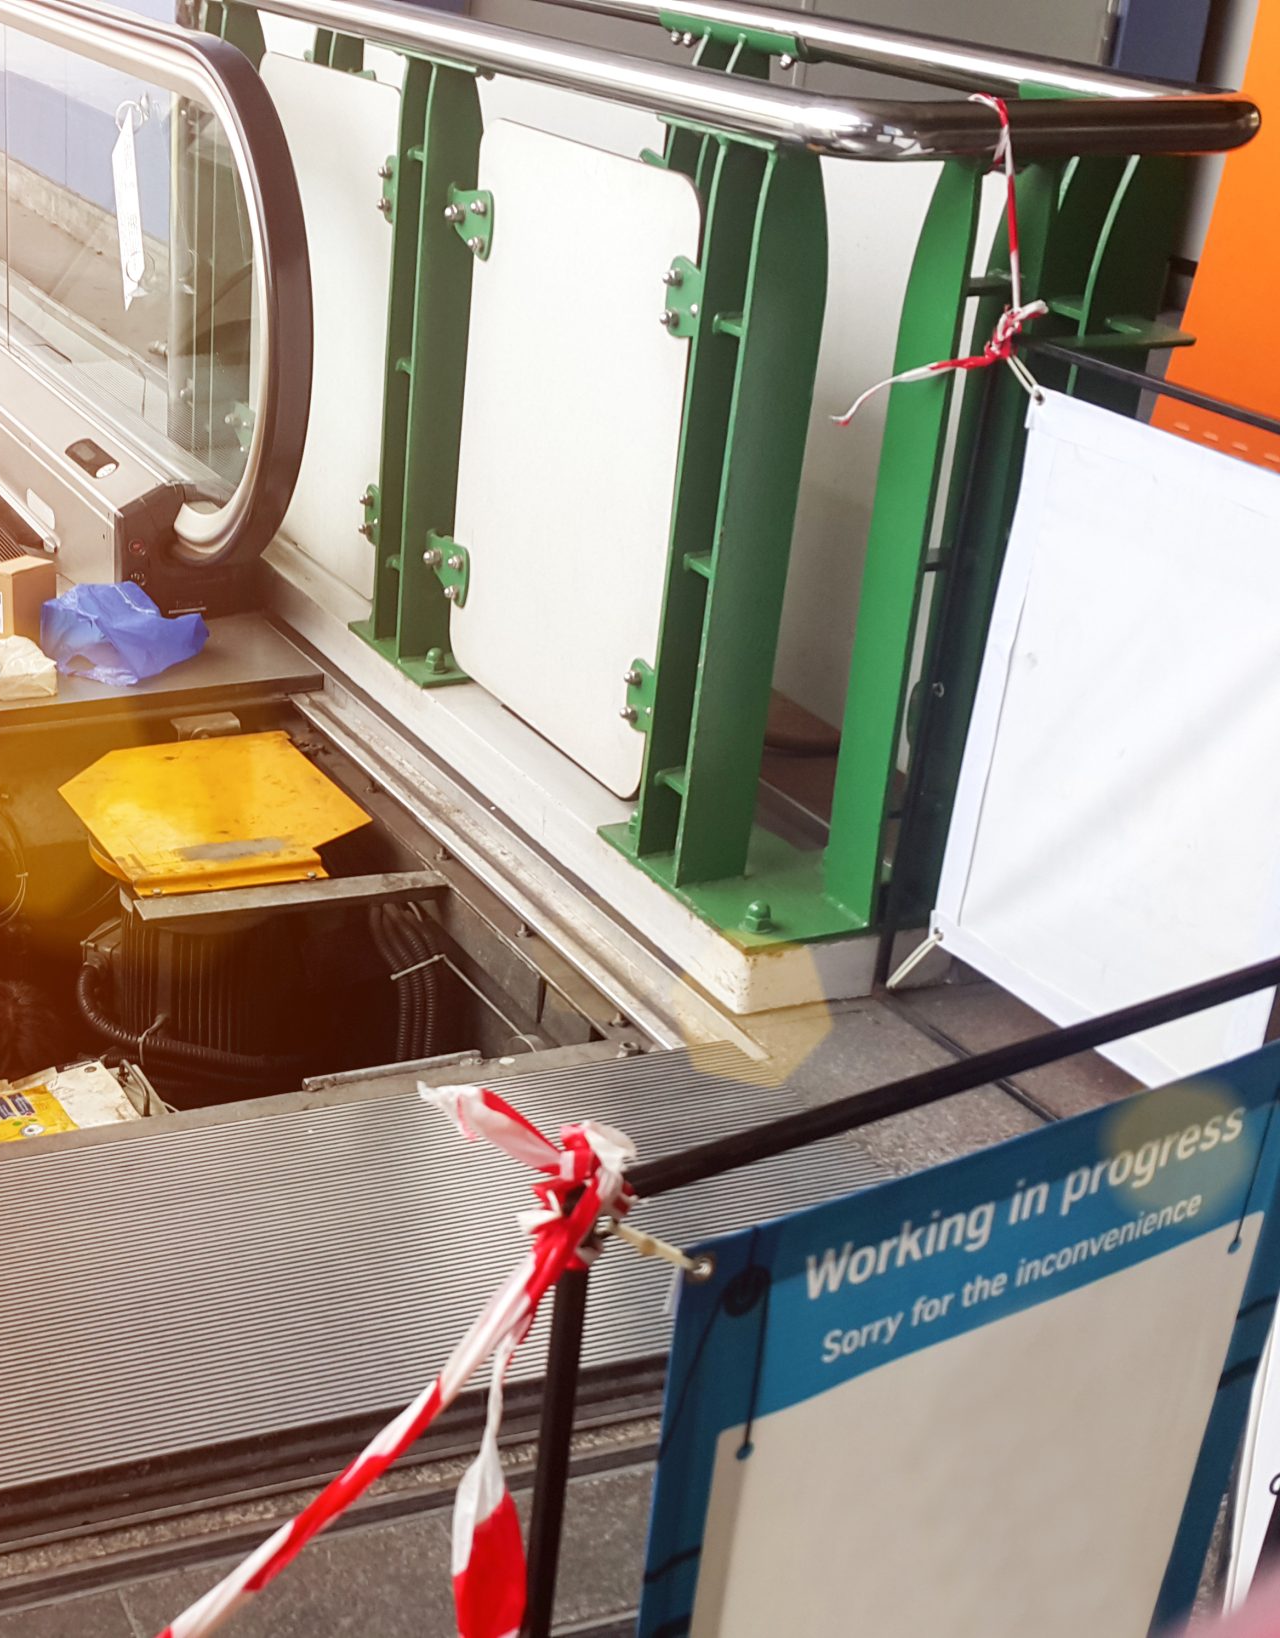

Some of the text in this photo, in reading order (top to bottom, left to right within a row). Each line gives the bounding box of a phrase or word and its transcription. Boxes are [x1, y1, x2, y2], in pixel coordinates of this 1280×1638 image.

[806, 1107, 1245, 1300] Working in progress
[822, 1193, 1203, 1363] Sorry for the inconvenience
